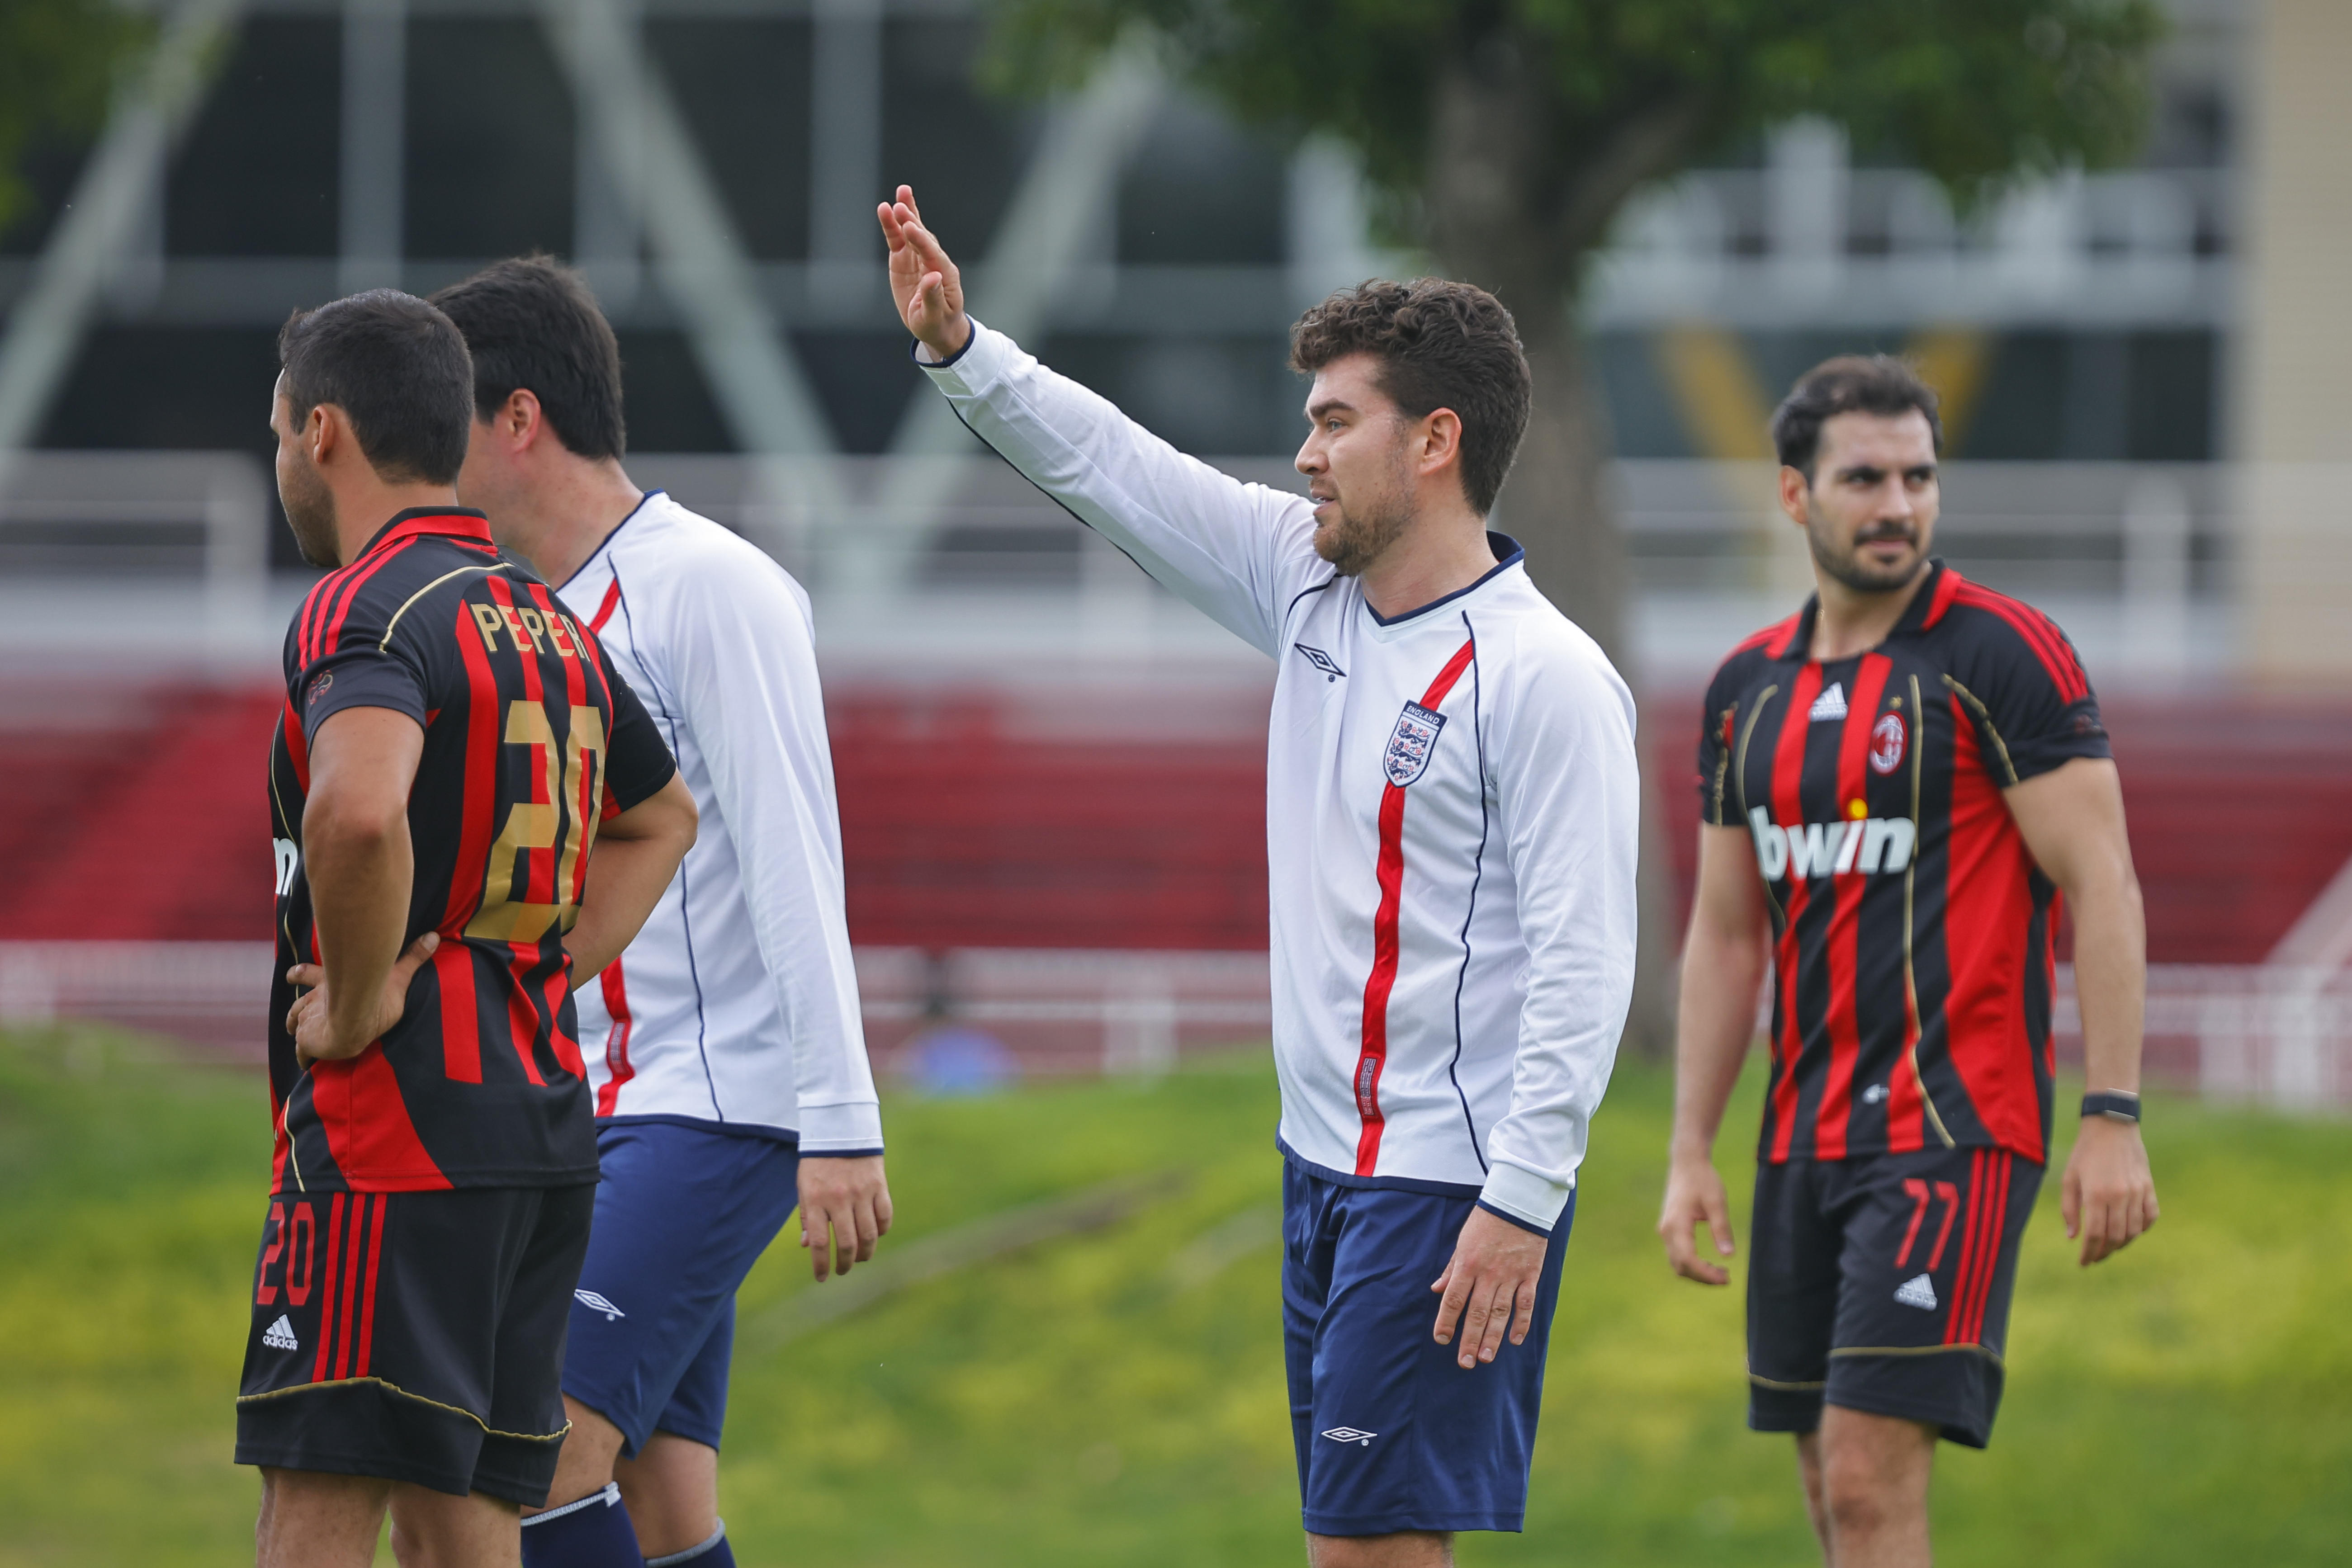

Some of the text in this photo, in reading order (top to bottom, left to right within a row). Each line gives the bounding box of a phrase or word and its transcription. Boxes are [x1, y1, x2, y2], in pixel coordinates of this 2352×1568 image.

[470, 604, 591, 662] PEPER
[1406, 705, 1440, 724] ENGLAND
[464, 700, 606, 943] 20
[1749, 797, 1916, 882] bwin
[256, 1202, 315, 1306] 20
[1895, 1178, 1959, 1271] 77
[263, 1335, 298, 1351] adidas
